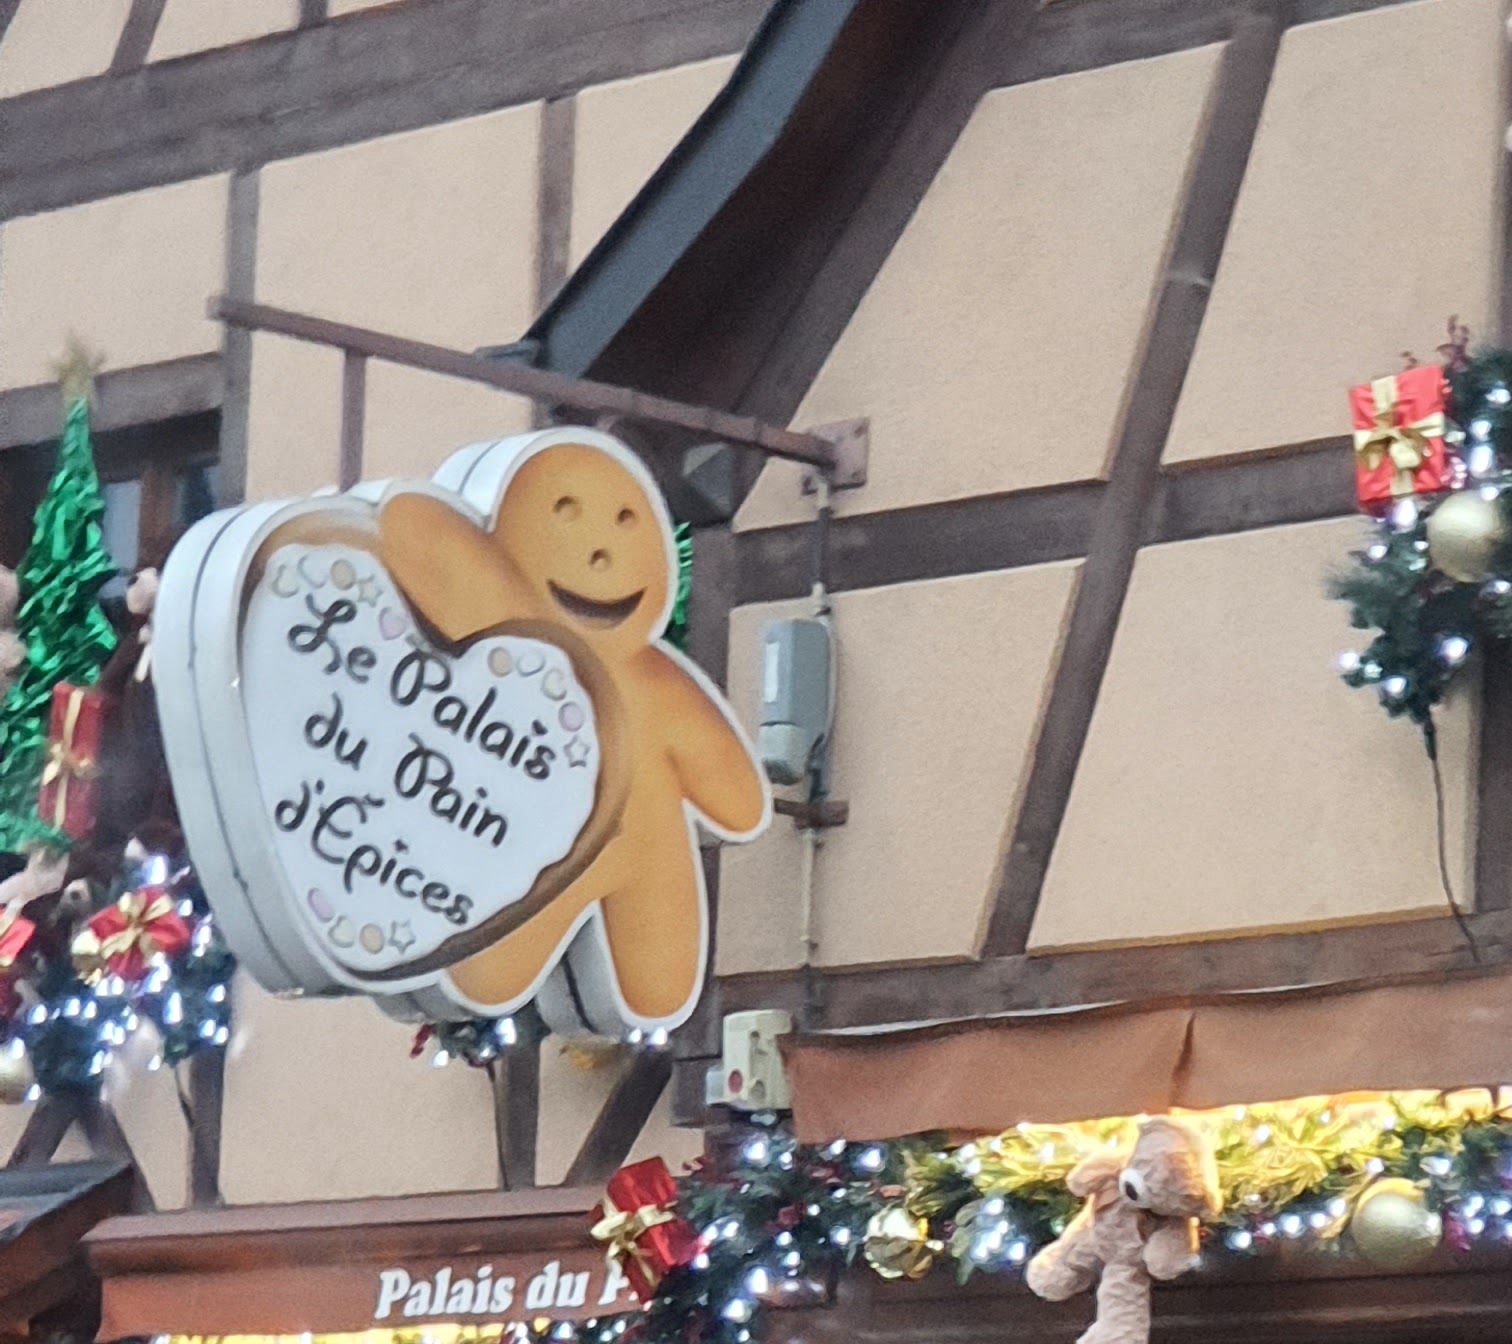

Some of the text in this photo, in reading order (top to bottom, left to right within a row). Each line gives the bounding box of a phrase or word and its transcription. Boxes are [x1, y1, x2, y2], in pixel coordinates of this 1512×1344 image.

[287, 593, 557, 781] Le Palais
[304, 691, 509, 848] du Pain
[374, 1263, 517, 1320] Palais
[526, 1260, 591, 1310] du
